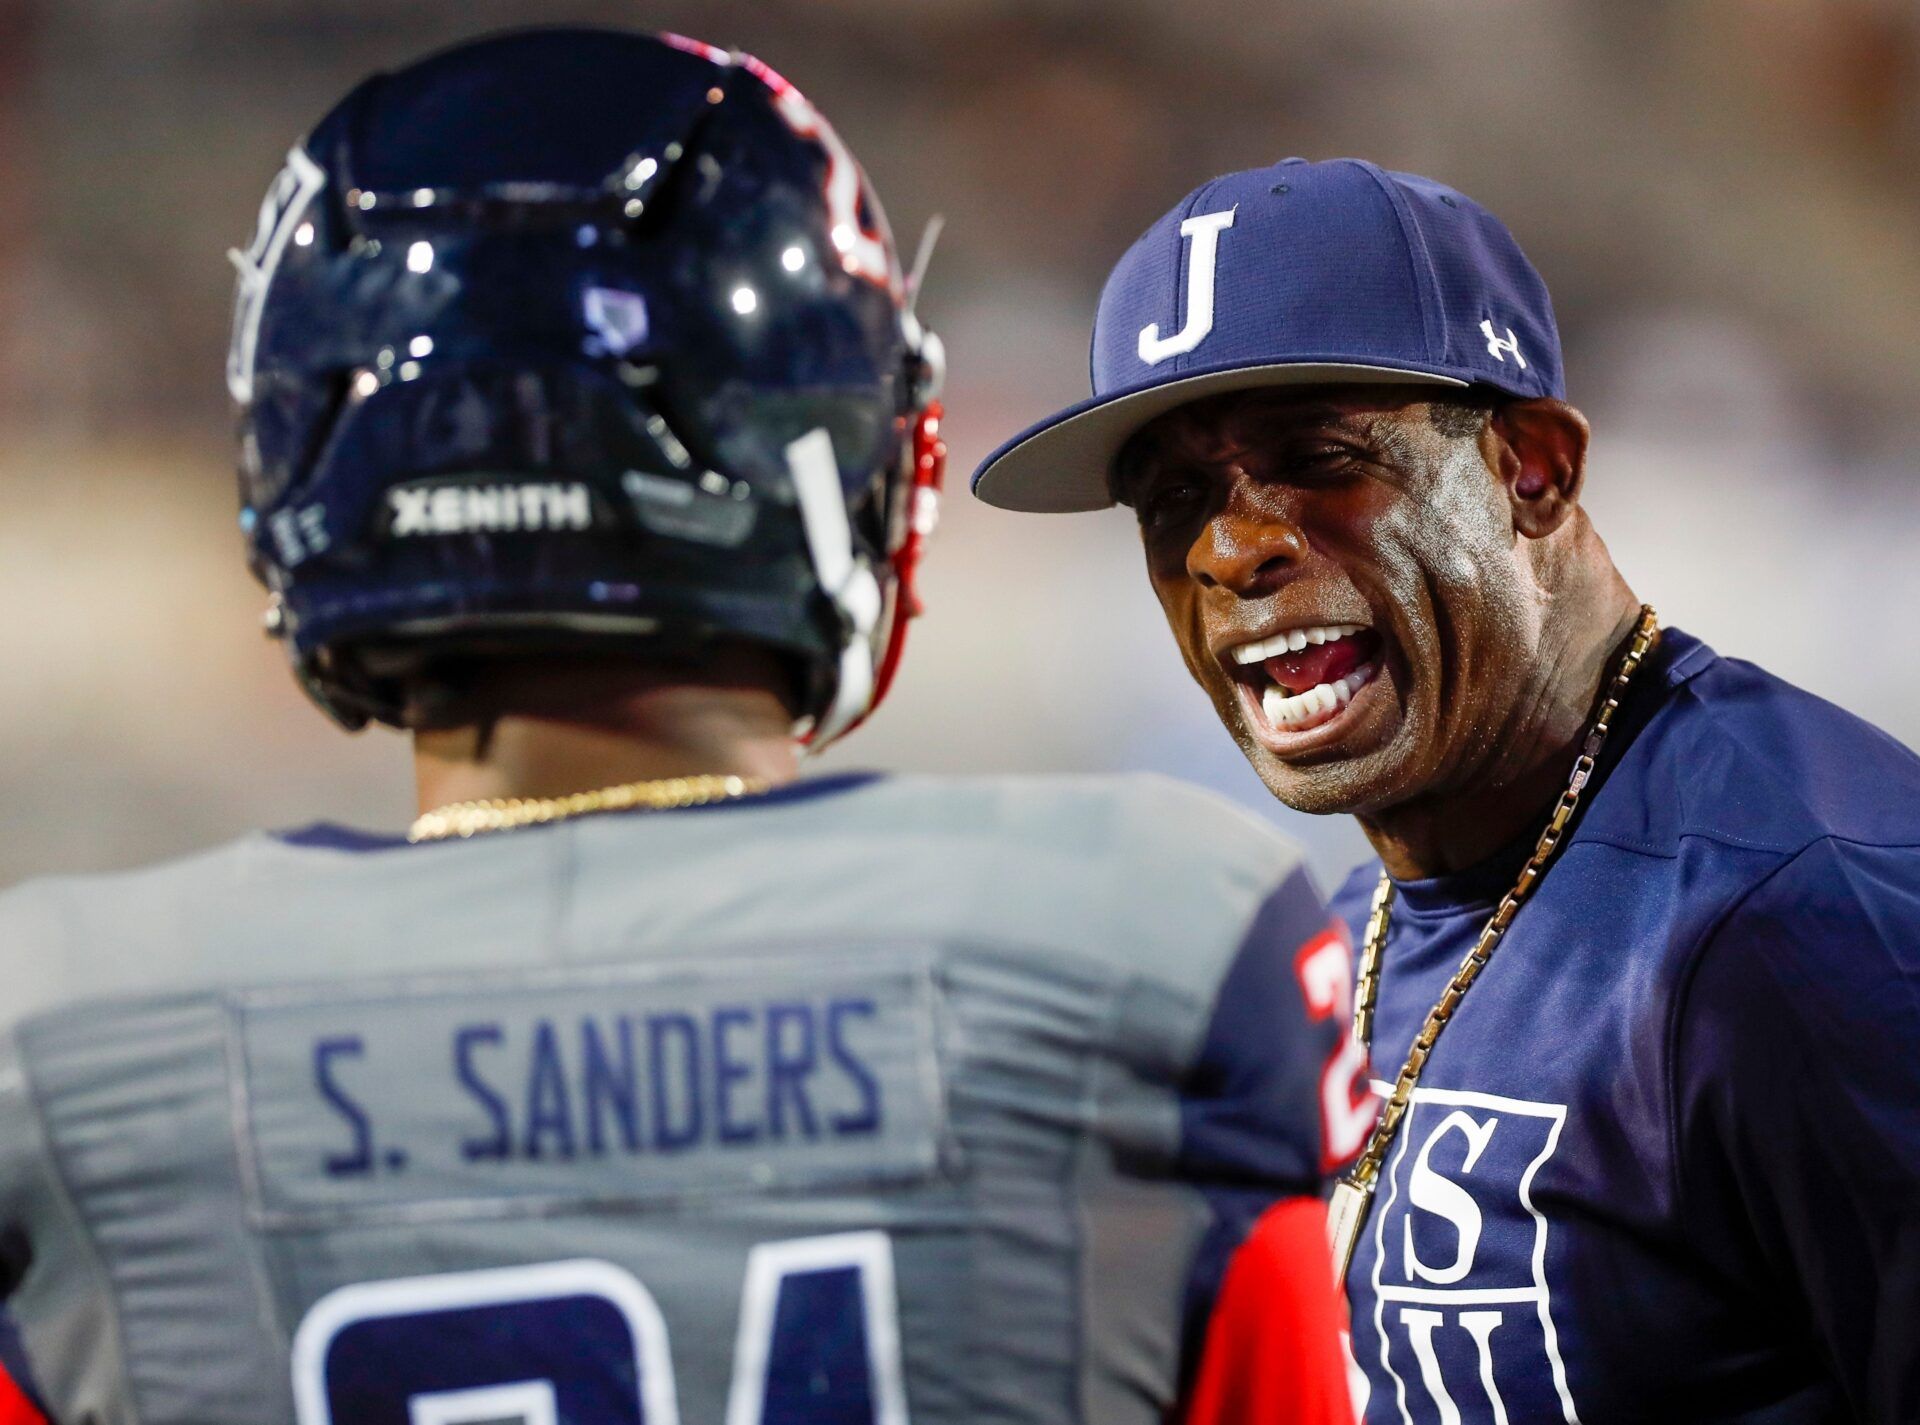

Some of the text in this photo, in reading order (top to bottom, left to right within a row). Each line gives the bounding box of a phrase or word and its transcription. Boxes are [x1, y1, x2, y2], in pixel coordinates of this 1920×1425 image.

[1138, 204, 1236, 366] J
[388, 483, 592, 537] XENITH
[313, 997, 883, 1177] S. SANDERS
